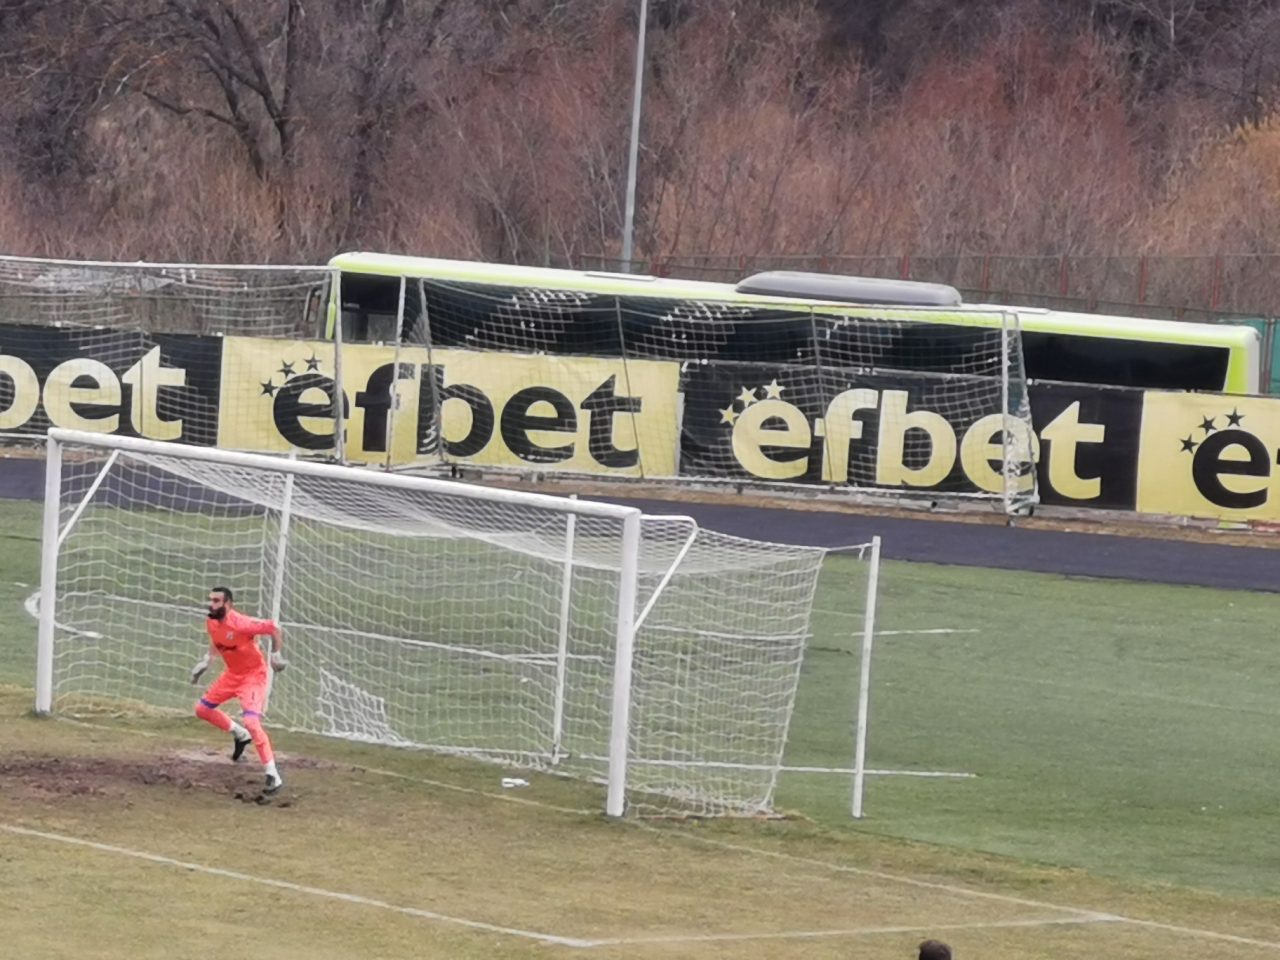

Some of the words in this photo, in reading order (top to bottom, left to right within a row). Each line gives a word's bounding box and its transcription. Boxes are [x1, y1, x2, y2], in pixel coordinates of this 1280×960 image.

[273, 363, 642, 468] efbet
[731, 389, 1105, 499] efbet
[1192, 429, 1280, 509] e
